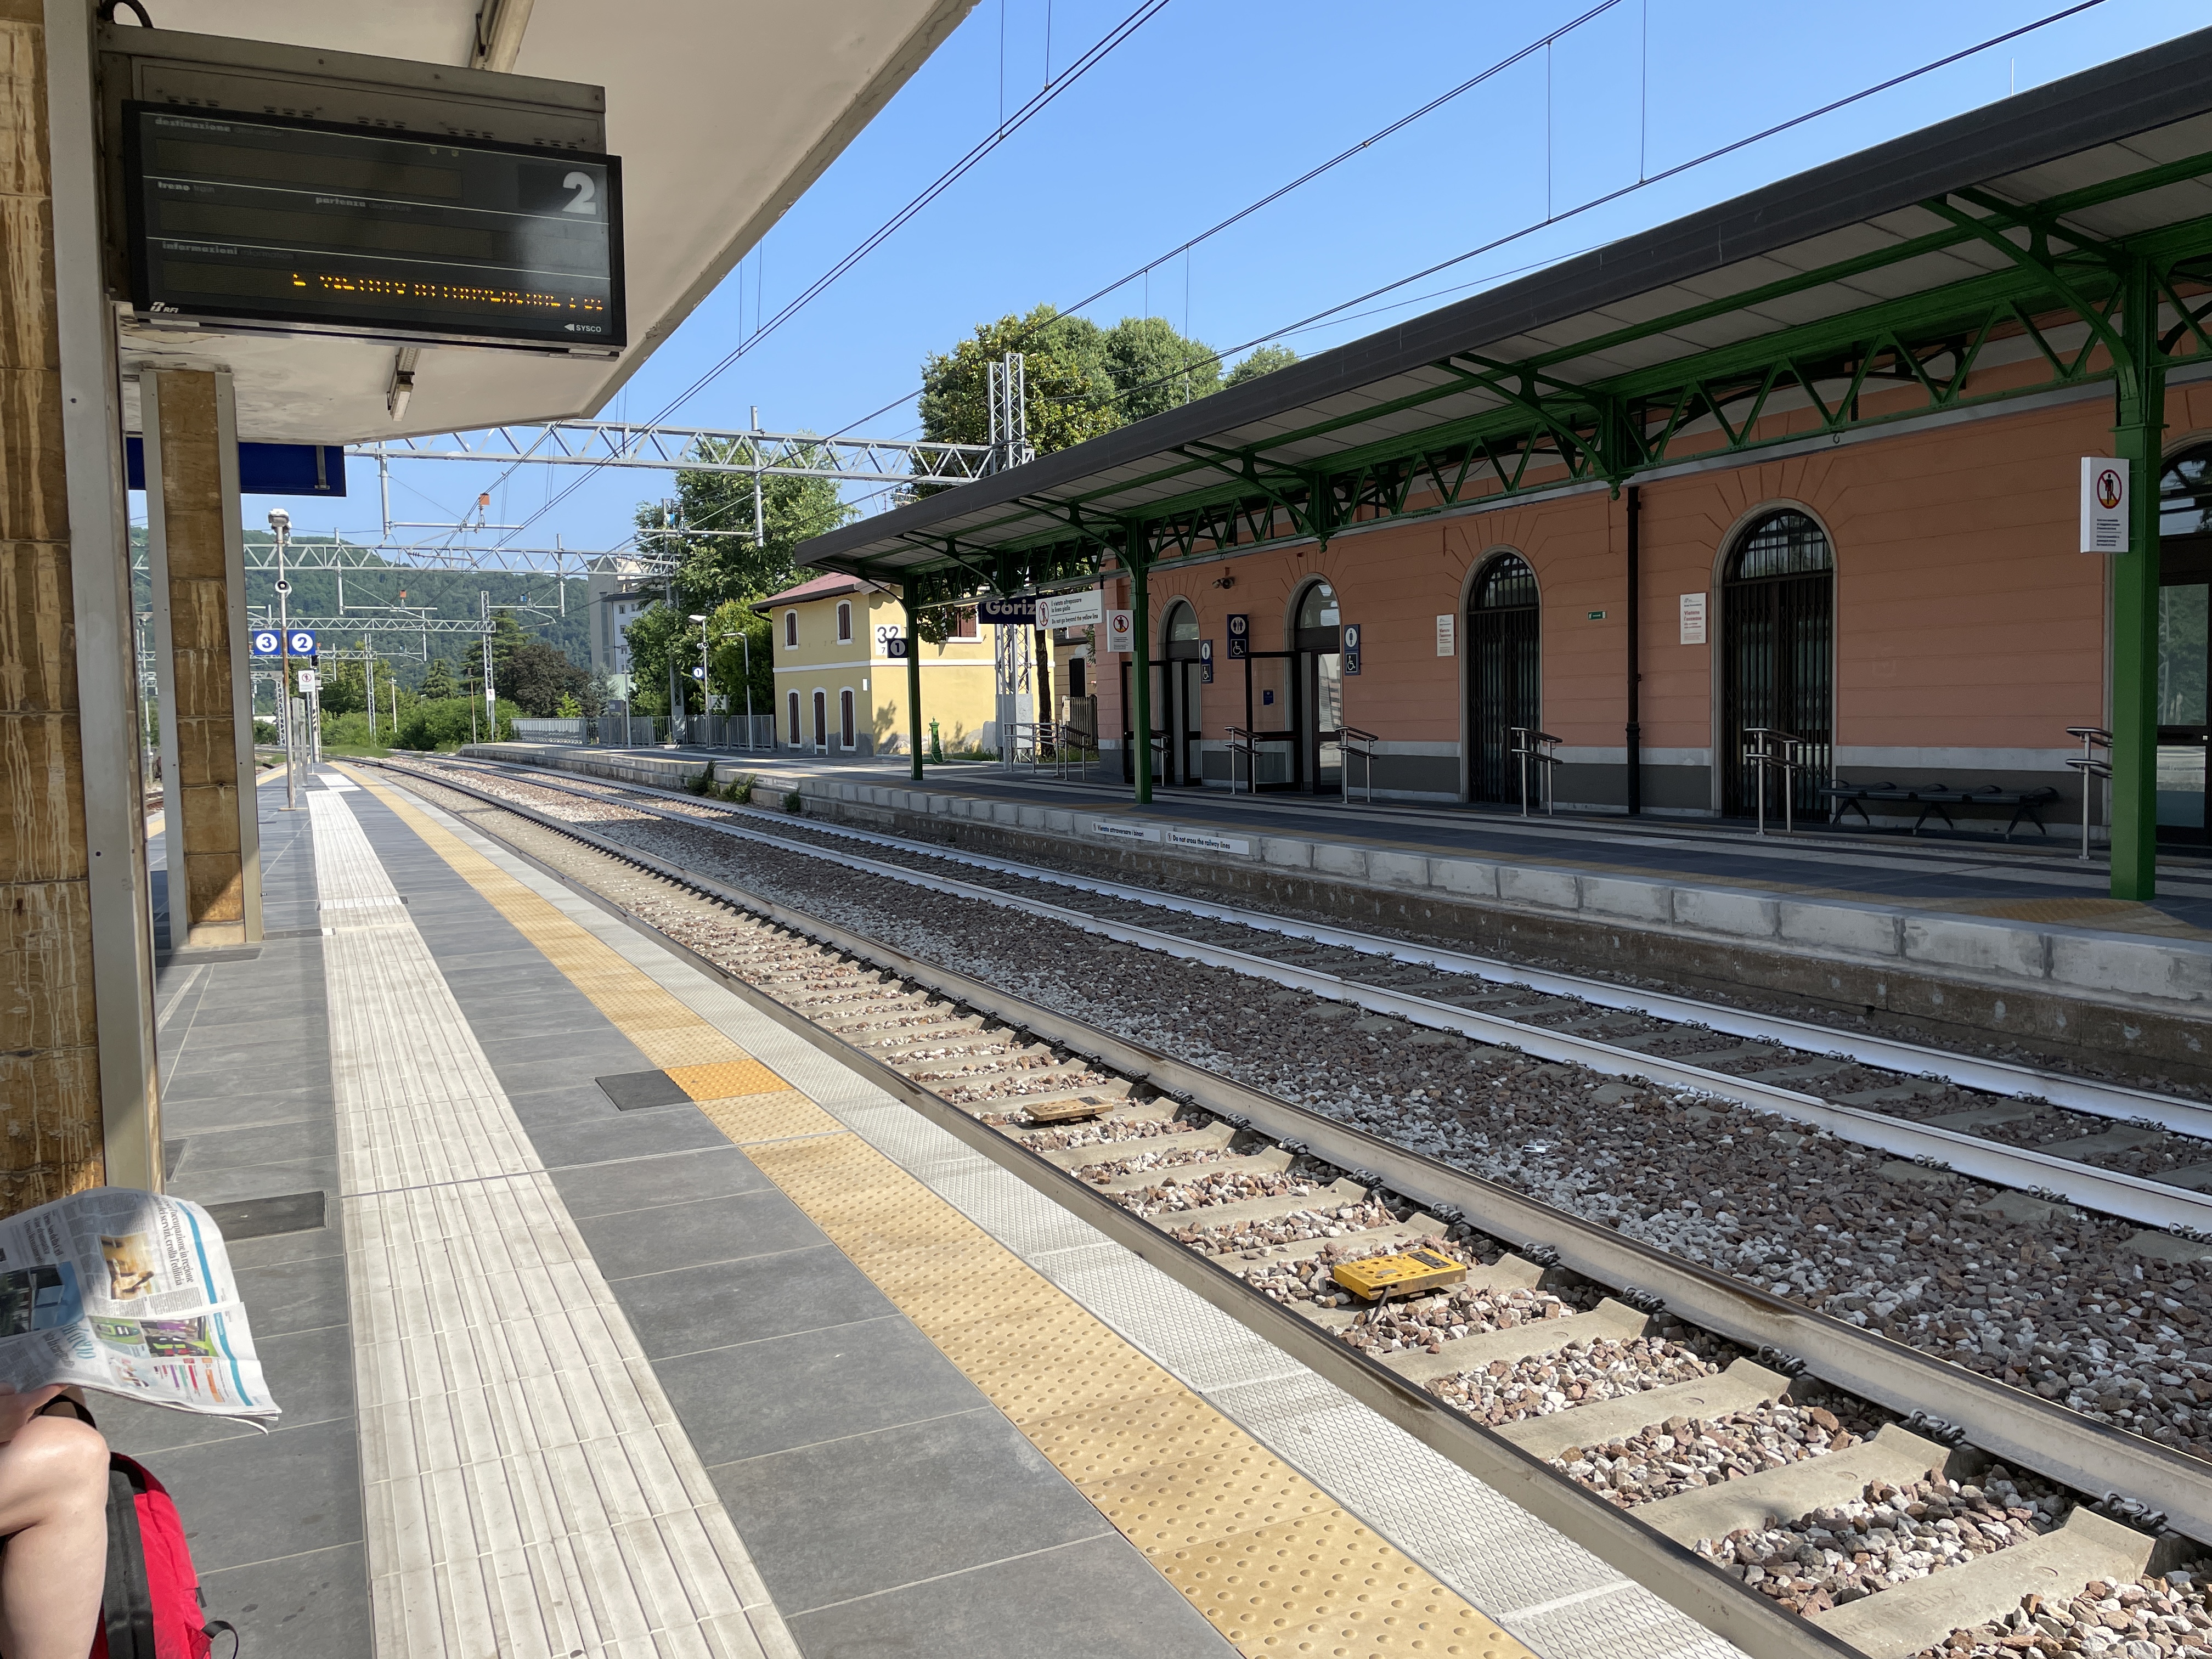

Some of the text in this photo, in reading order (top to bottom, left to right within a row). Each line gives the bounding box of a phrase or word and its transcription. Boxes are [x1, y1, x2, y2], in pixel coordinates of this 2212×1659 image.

[157, 181, 190, 191] treno
[562, 172, 597, 215] 2
[315, 197, 366, 207] partenza
[162, 241, 238, 255] informazioni
[575, 324, 602, 332] SYSCO
[877, 625, 899, 644] 32
[262, 636, 272, 648] 3
[297, 636, 308, 648] 2
[895, 642, 900, 653] 1
[1204, 839, 1220, 849] railway
[1220, 840, 1230, 849] lines
[165, 1239, 179, 1259] crolla
[181, 1259, 194, 1283] regione
